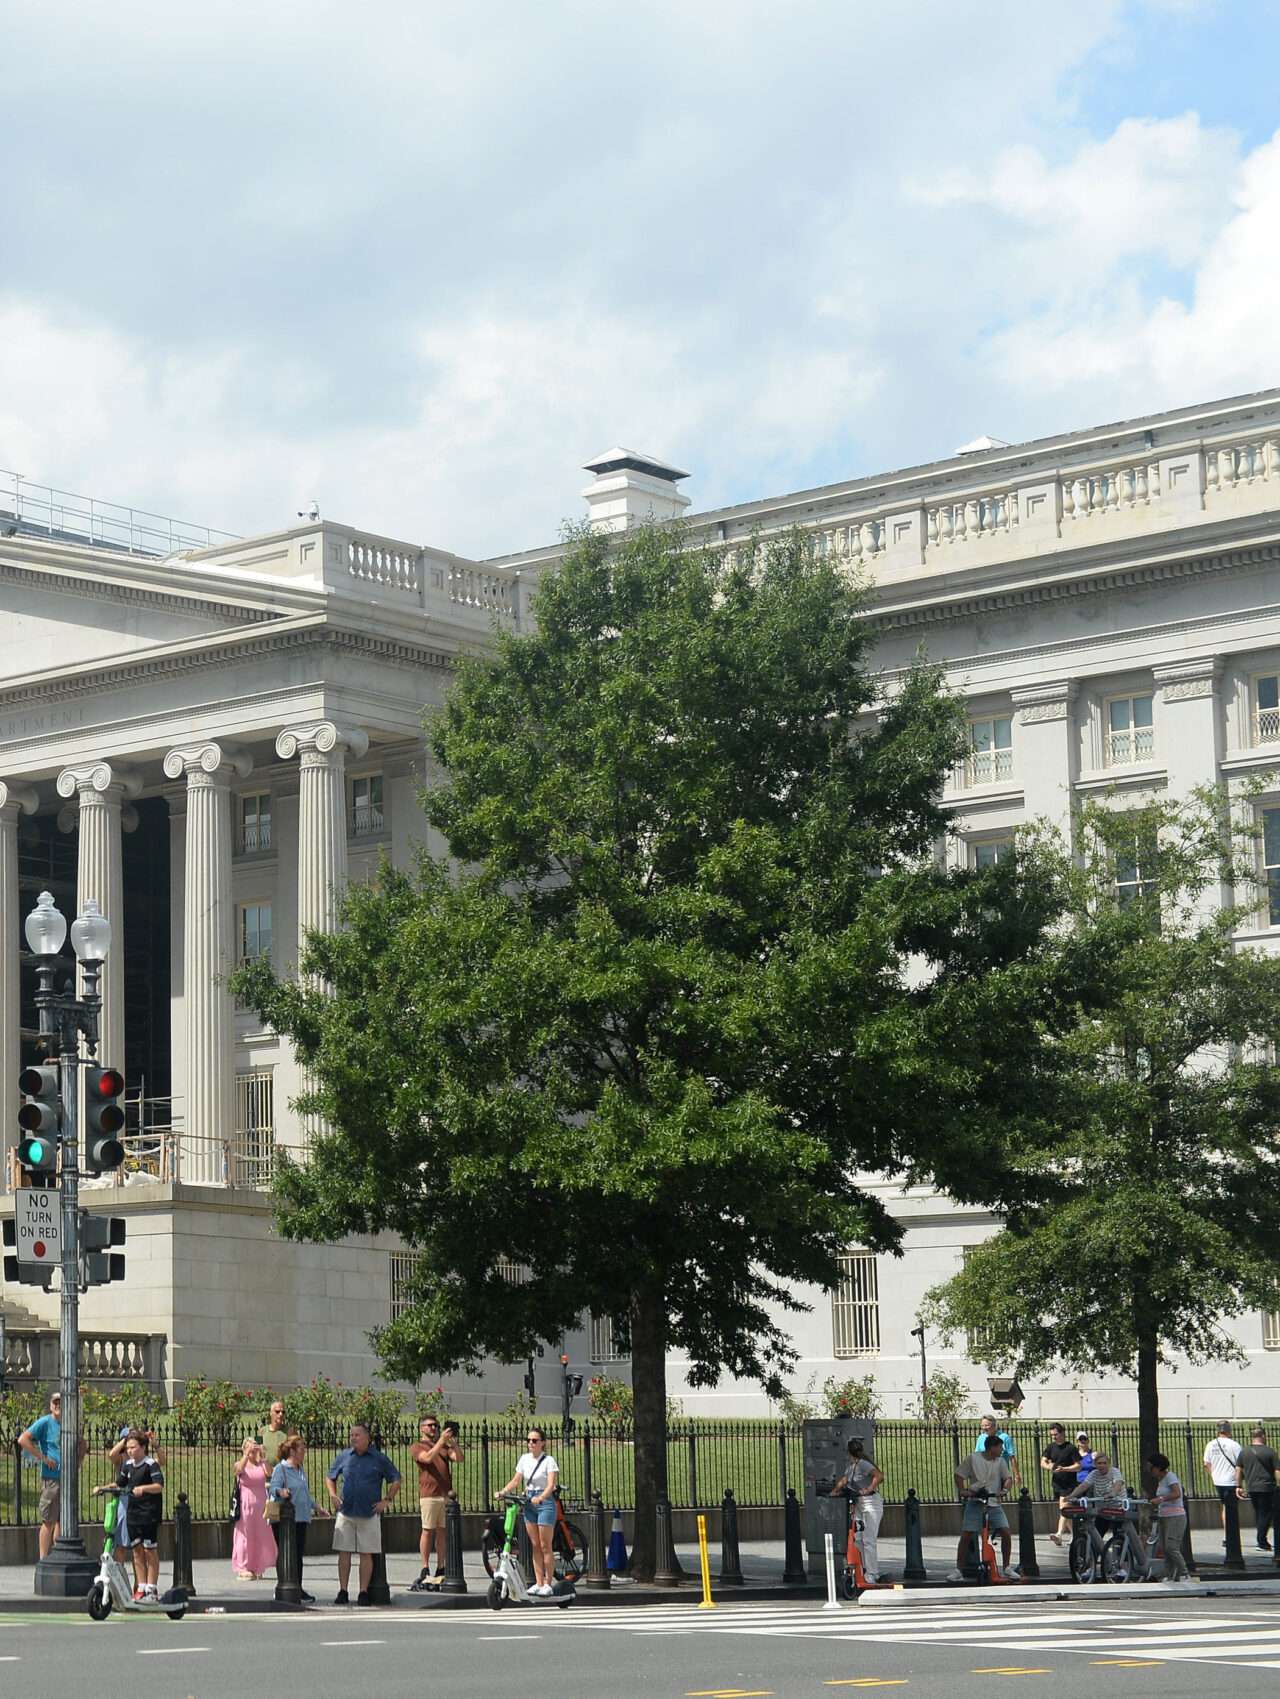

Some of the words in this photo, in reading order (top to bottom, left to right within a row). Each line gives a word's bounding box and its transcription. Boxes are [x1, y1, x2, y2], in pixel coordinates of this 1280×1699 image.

[29, 1194, 49, 1208] NO
[26, 1211, 52, 1223] TURN
[20, 1226, 34, 1238] ON
[38, 1227, 58, 1239] RED
